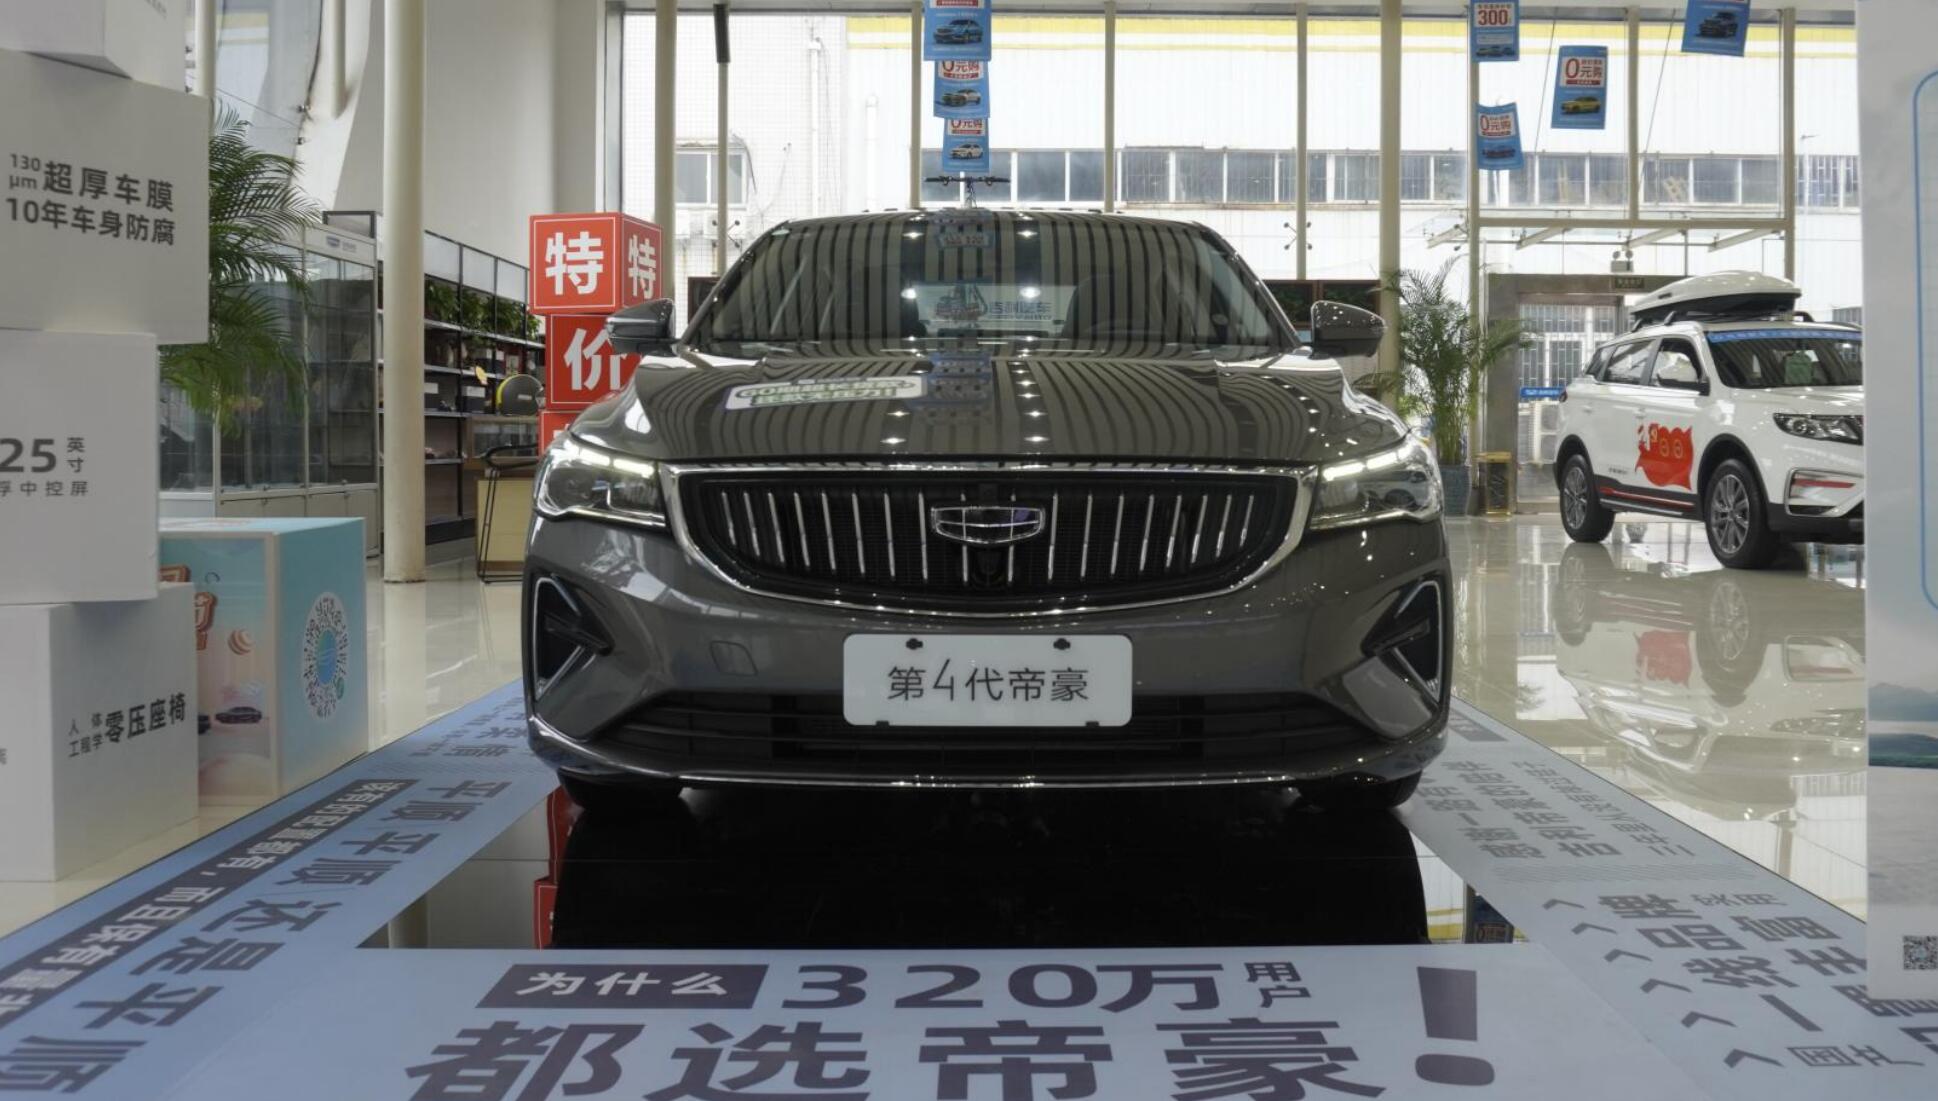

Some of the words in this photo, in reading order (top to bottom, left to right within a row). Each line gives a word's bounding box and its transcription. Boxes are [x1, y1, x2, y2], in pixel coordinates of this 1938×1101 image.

[1478, 9, 1508, 26] 300
[10, 153, 41, 172] 130
[43, 160, 174, 213] 超厚车膜
[5, 198, 175, 246] 10年车身防腐
[545, 231, 604, 296] 特
[628, 233, 657, 300] 特
[66, 437, 86, 473] 英寸
[887, 658, 1089, 702] 第4代帝豪
[104, 692, 186, 744] 零压座椅
[516, 971, 728, 997] 为什么
[781, 964, 1224, 1013] 320万
[1244, 961, 1312, 1009] 用户
[1598, 894, 1825, 1033] 一线品牌
[406, 1017, 1388, 1101] 都选帝豪
[1787, 1045, 1926, 1068] 国产
